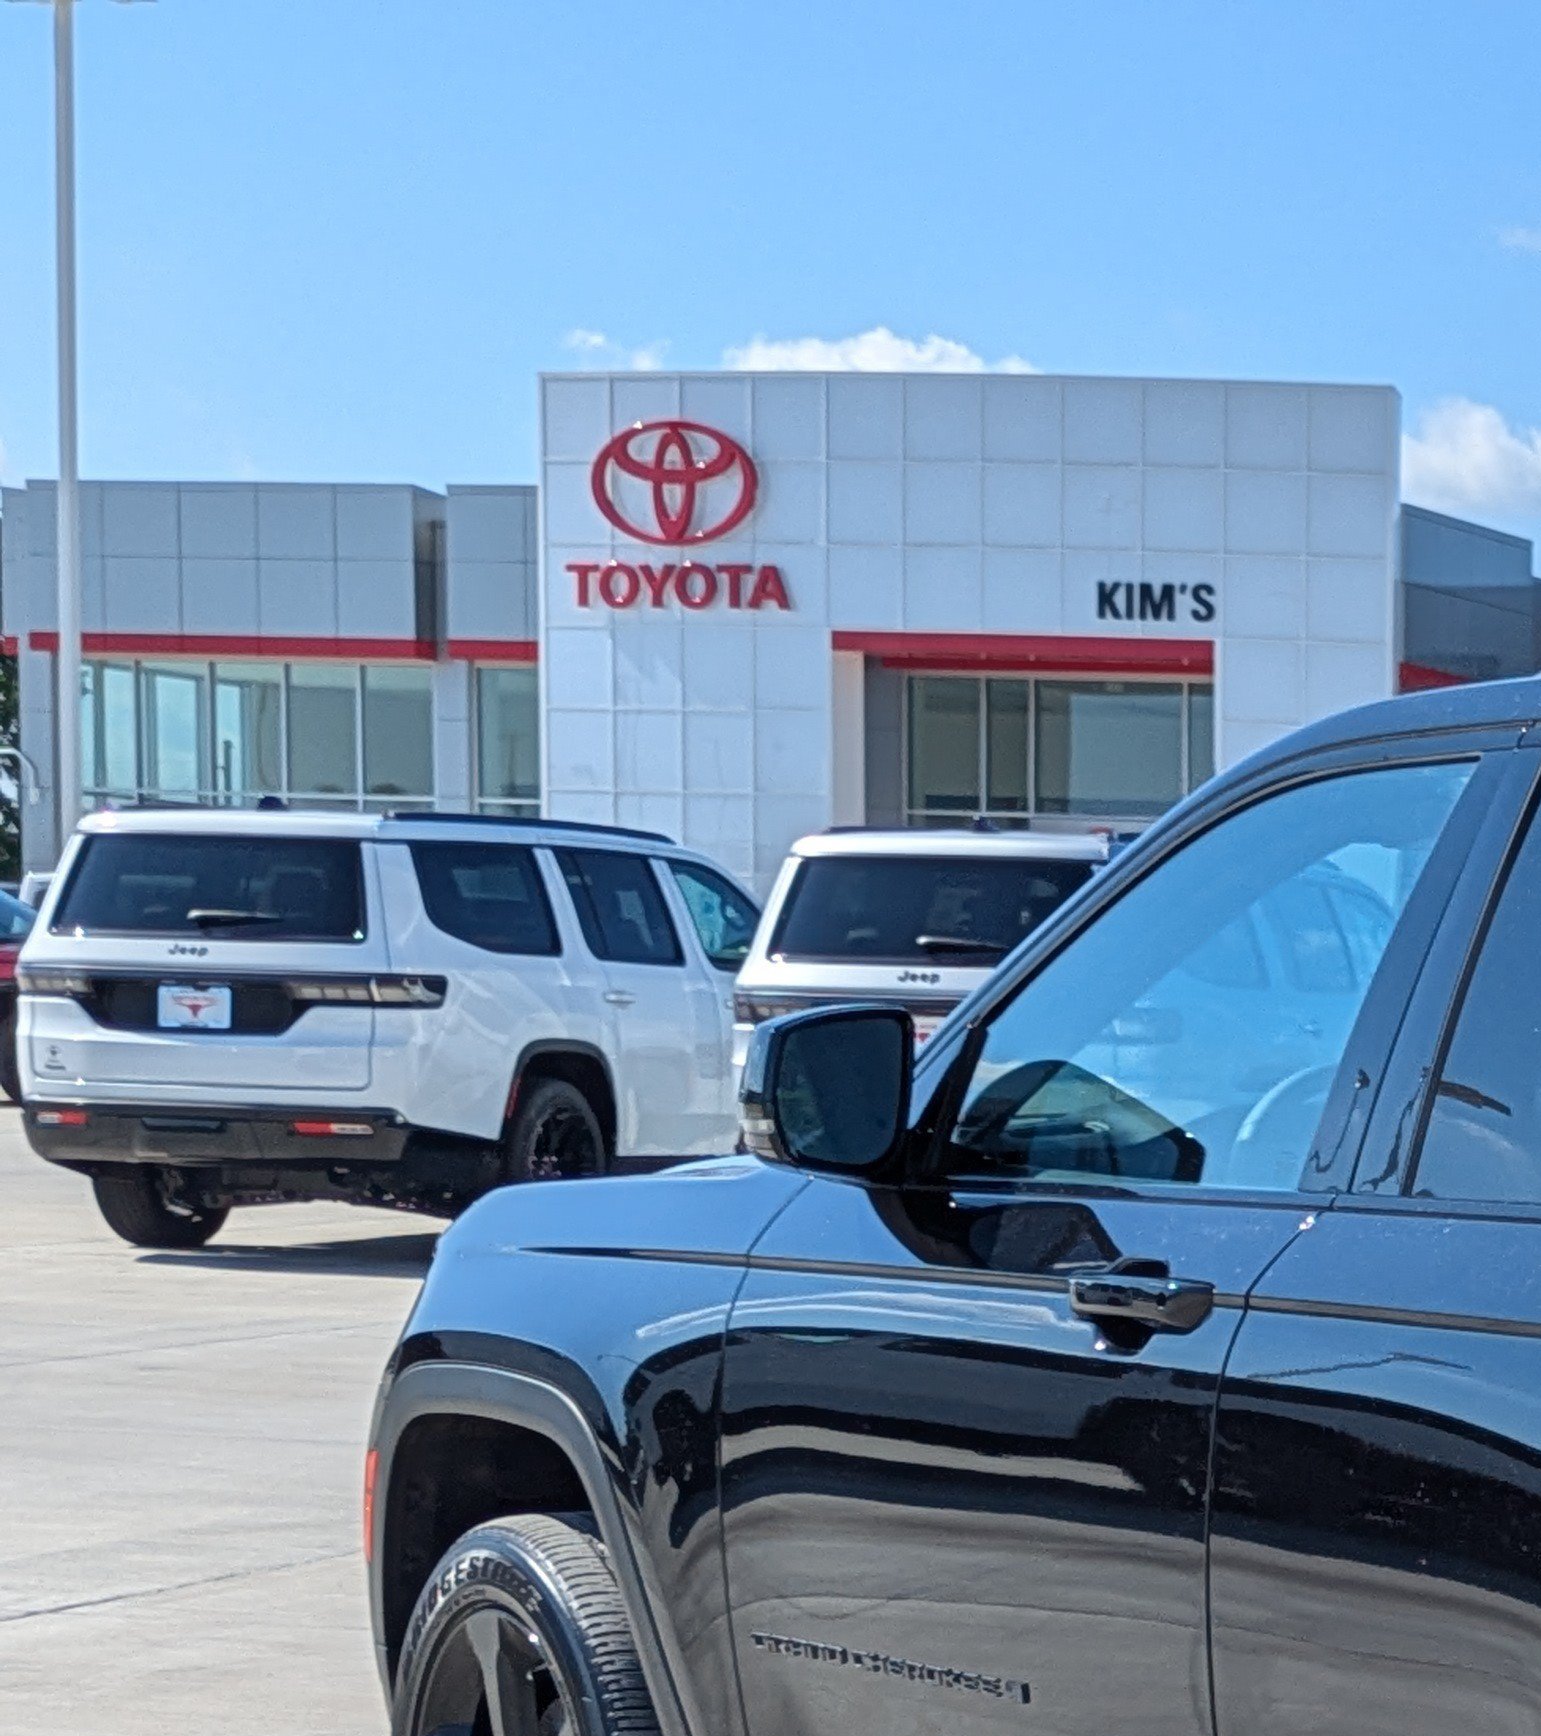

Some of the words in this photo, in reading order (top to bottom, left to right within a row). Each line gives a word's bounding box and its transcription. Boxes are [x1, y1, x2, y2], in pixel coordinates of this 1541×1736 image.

[566, 563, 791, 609] TOYOTA
[1097, 581, 1216, 622] KIM'S
[168, 944, 209, 957] Jeep
[897, 971, 940, 984] Jeep
